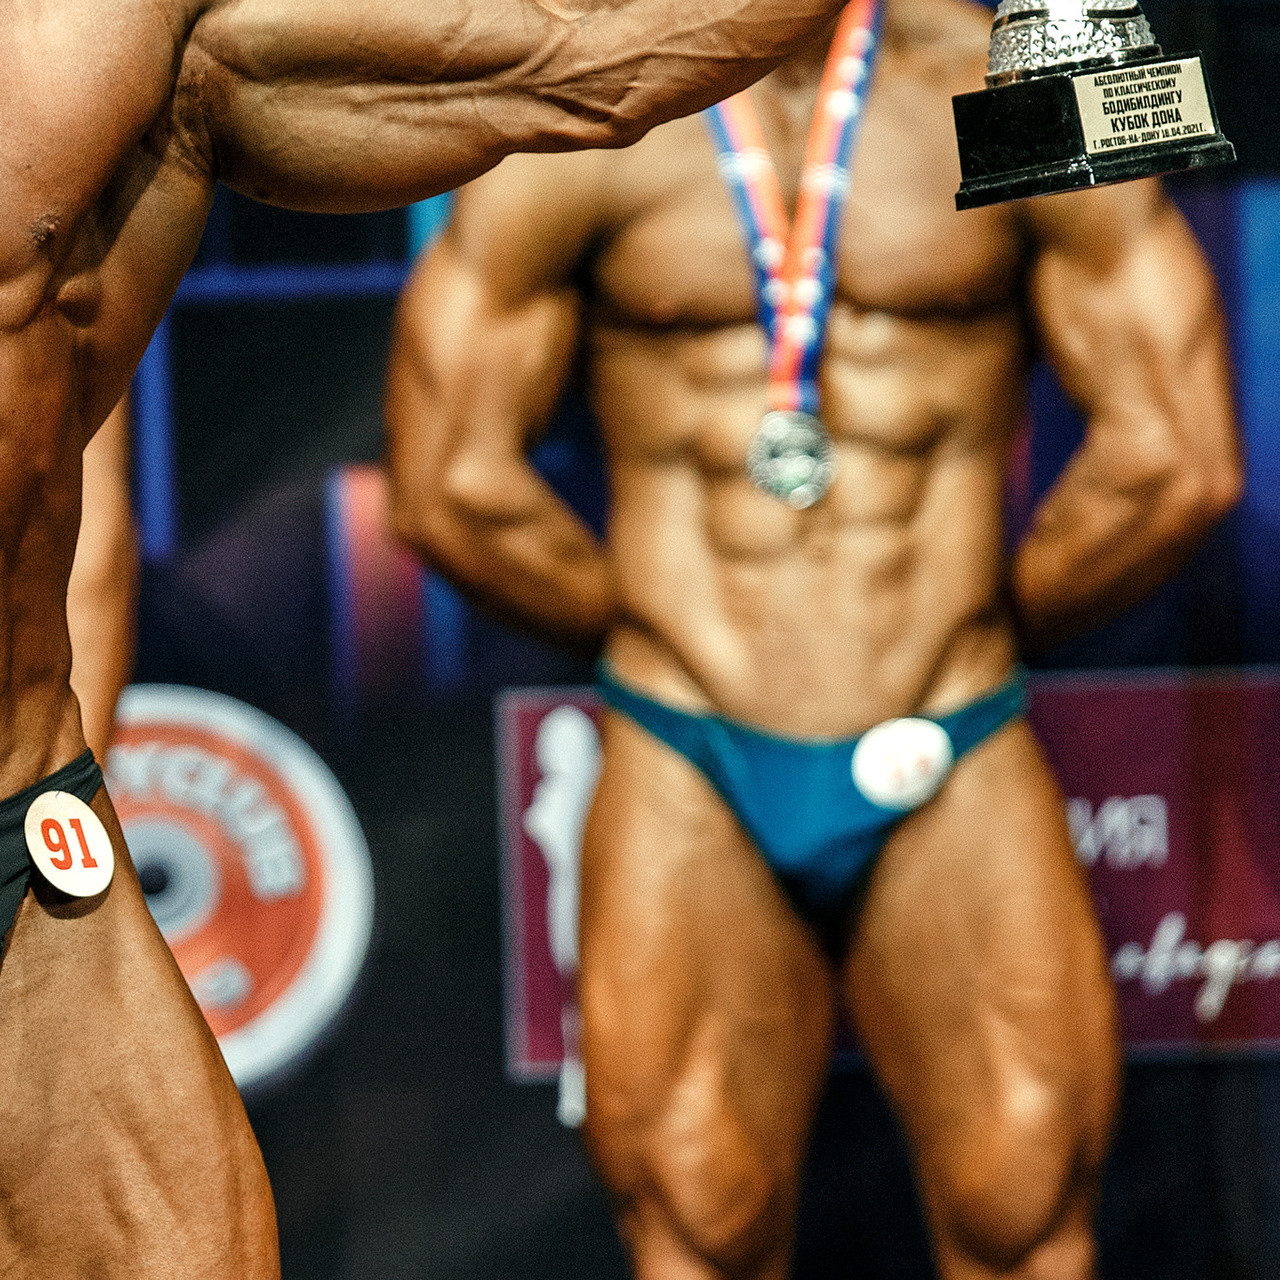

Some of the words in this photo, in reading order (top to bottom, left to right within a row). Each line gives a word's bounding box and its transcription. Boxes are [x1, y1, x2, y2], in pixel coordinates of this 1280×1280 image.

[1094, 68, 1147, 87] АБСОЛЮТНЫЙ
[1147, 64, 1182, 78] ЧЕМПИОН
[1103, 87, 1114, 99] ПО
[1114, 77, 1177, 96] КЛАССИЧЕСКОМУ
[1102, 90, 1182, 115] БОДИБИЛДИНГУ
[1111, 113, 1150, 133] КУБОК
[1152, 107, 1183, 129] ДОНА
[41, 818, 98, 870] 91
